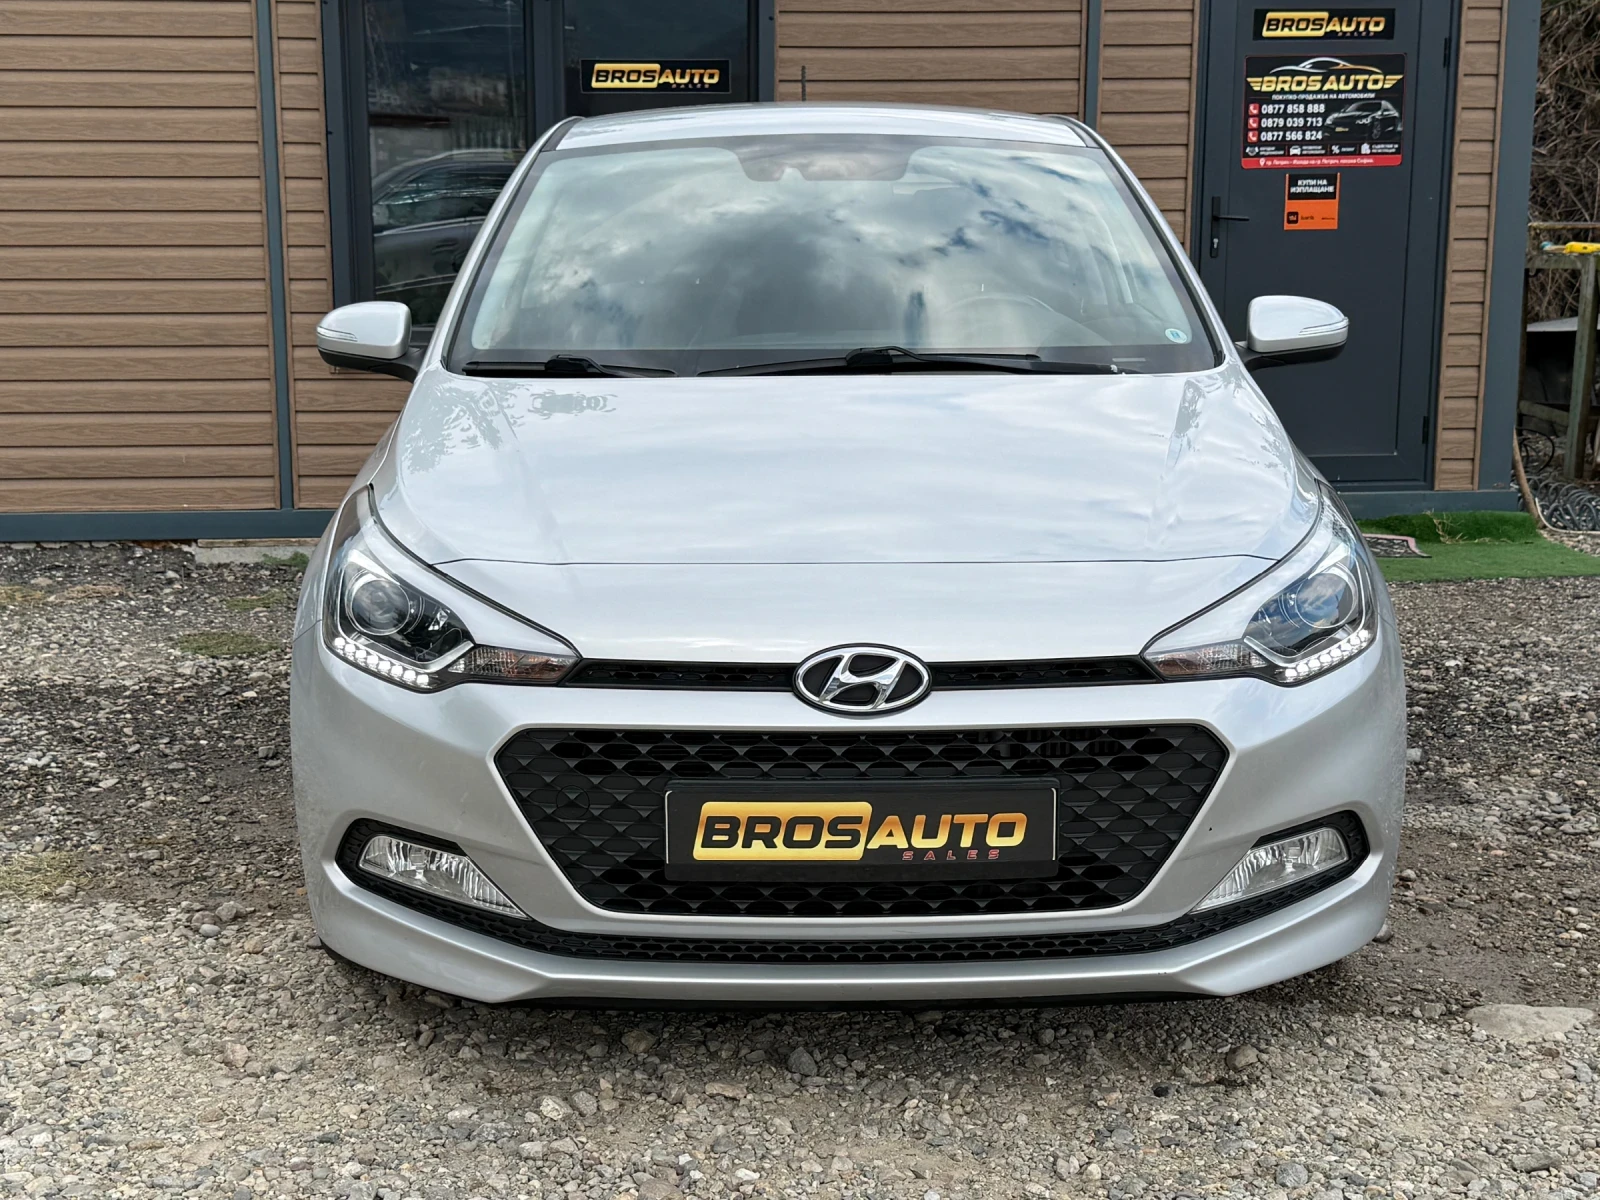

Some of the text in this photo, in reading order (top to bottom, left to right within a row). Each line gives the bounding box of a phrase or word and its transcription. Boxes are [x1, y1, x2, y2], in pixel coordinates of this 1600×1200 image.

[1261, 103, 1325, 114] 0877 858 888
[1260, 117, 1323, 128] 0879 039 713
[1260, 131, 1323, 141] 0877 566 824
[902, 849, 1000, 861] SALES
